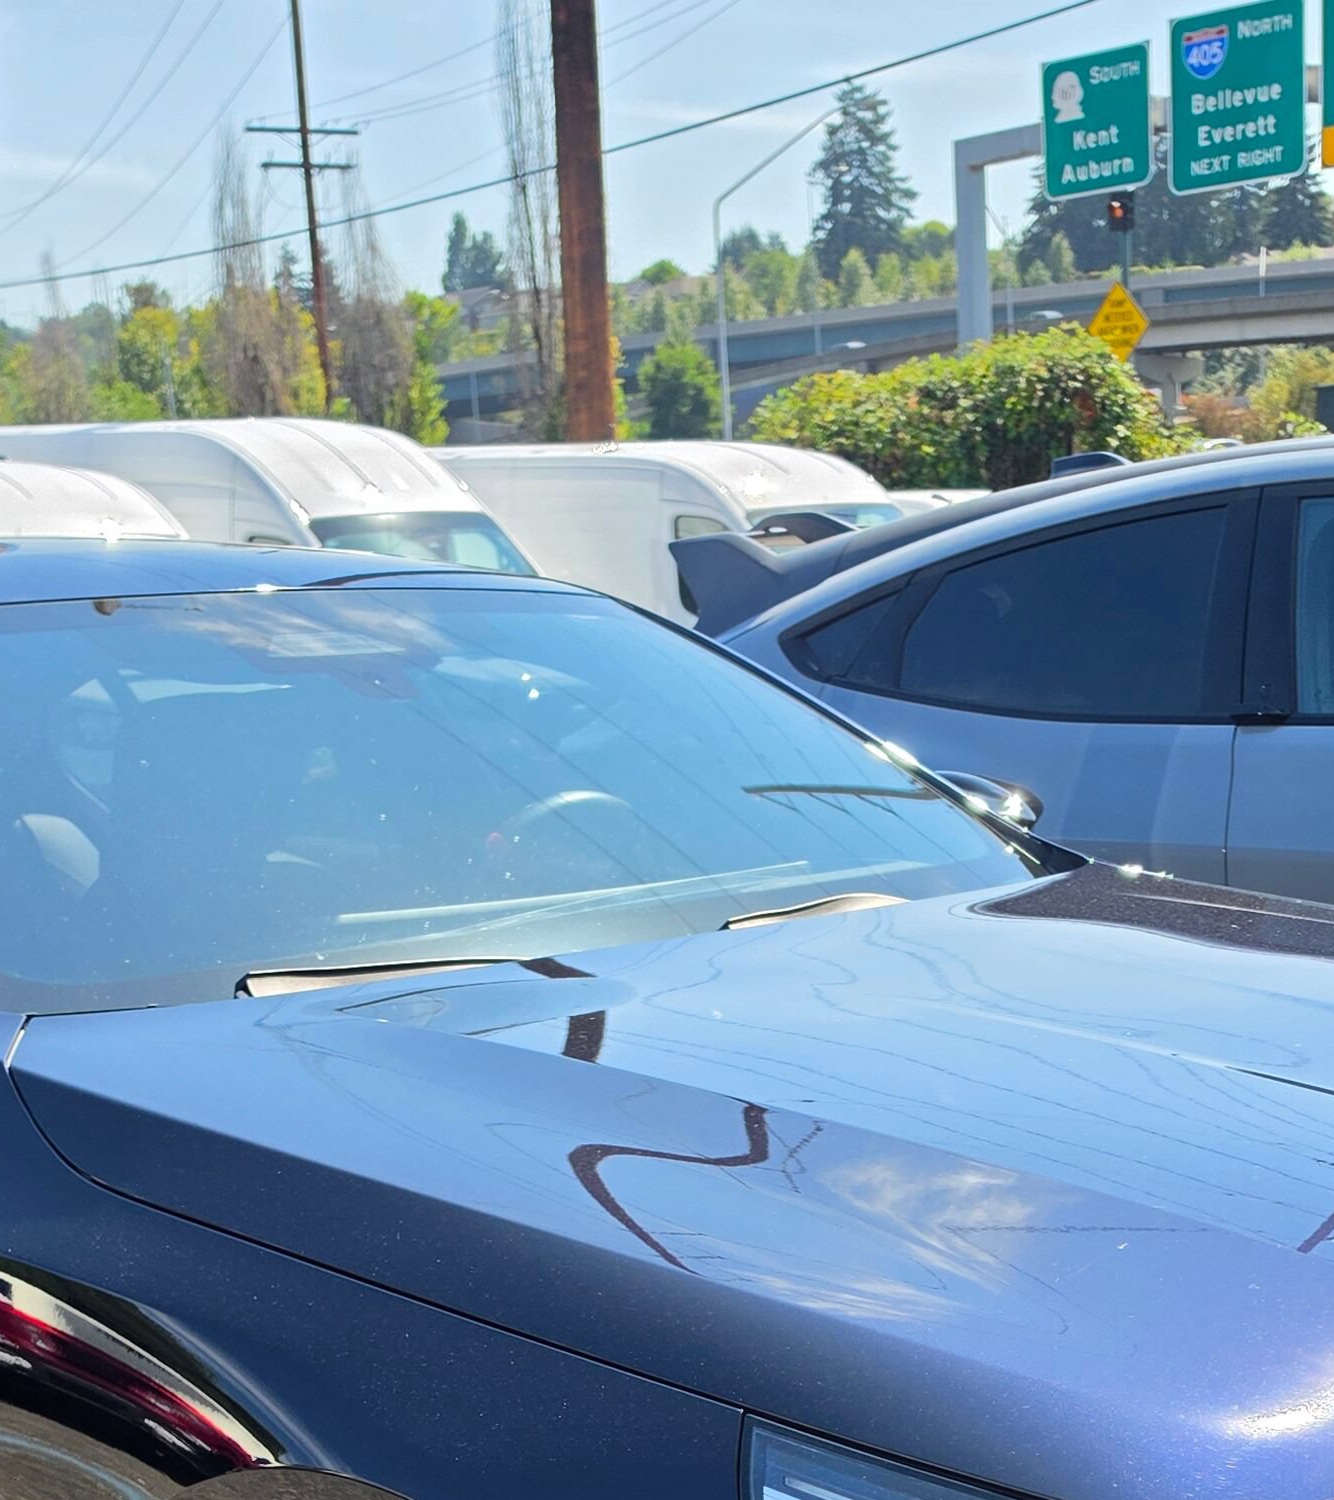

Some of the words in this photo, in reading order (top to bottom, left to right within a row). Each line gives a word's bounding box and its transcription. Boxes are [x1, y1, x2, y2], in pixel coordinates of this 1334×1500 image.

[1237, 14, 1293, 39] NORTH
[1187, 41, 1224, 67] 405
[1089, 60, 1140, 84] SOUTH
[1191, 83, 1282, 115] Bellevue
[1073, 124, 1119, 151] Kent
[1198, 114, 1276, 147] Everett
[1061, 156, 1134, 184] Auburn
[1190, 155, 1231, 176] NEXT
[1237, 145, 1283, 168] RIGHT
